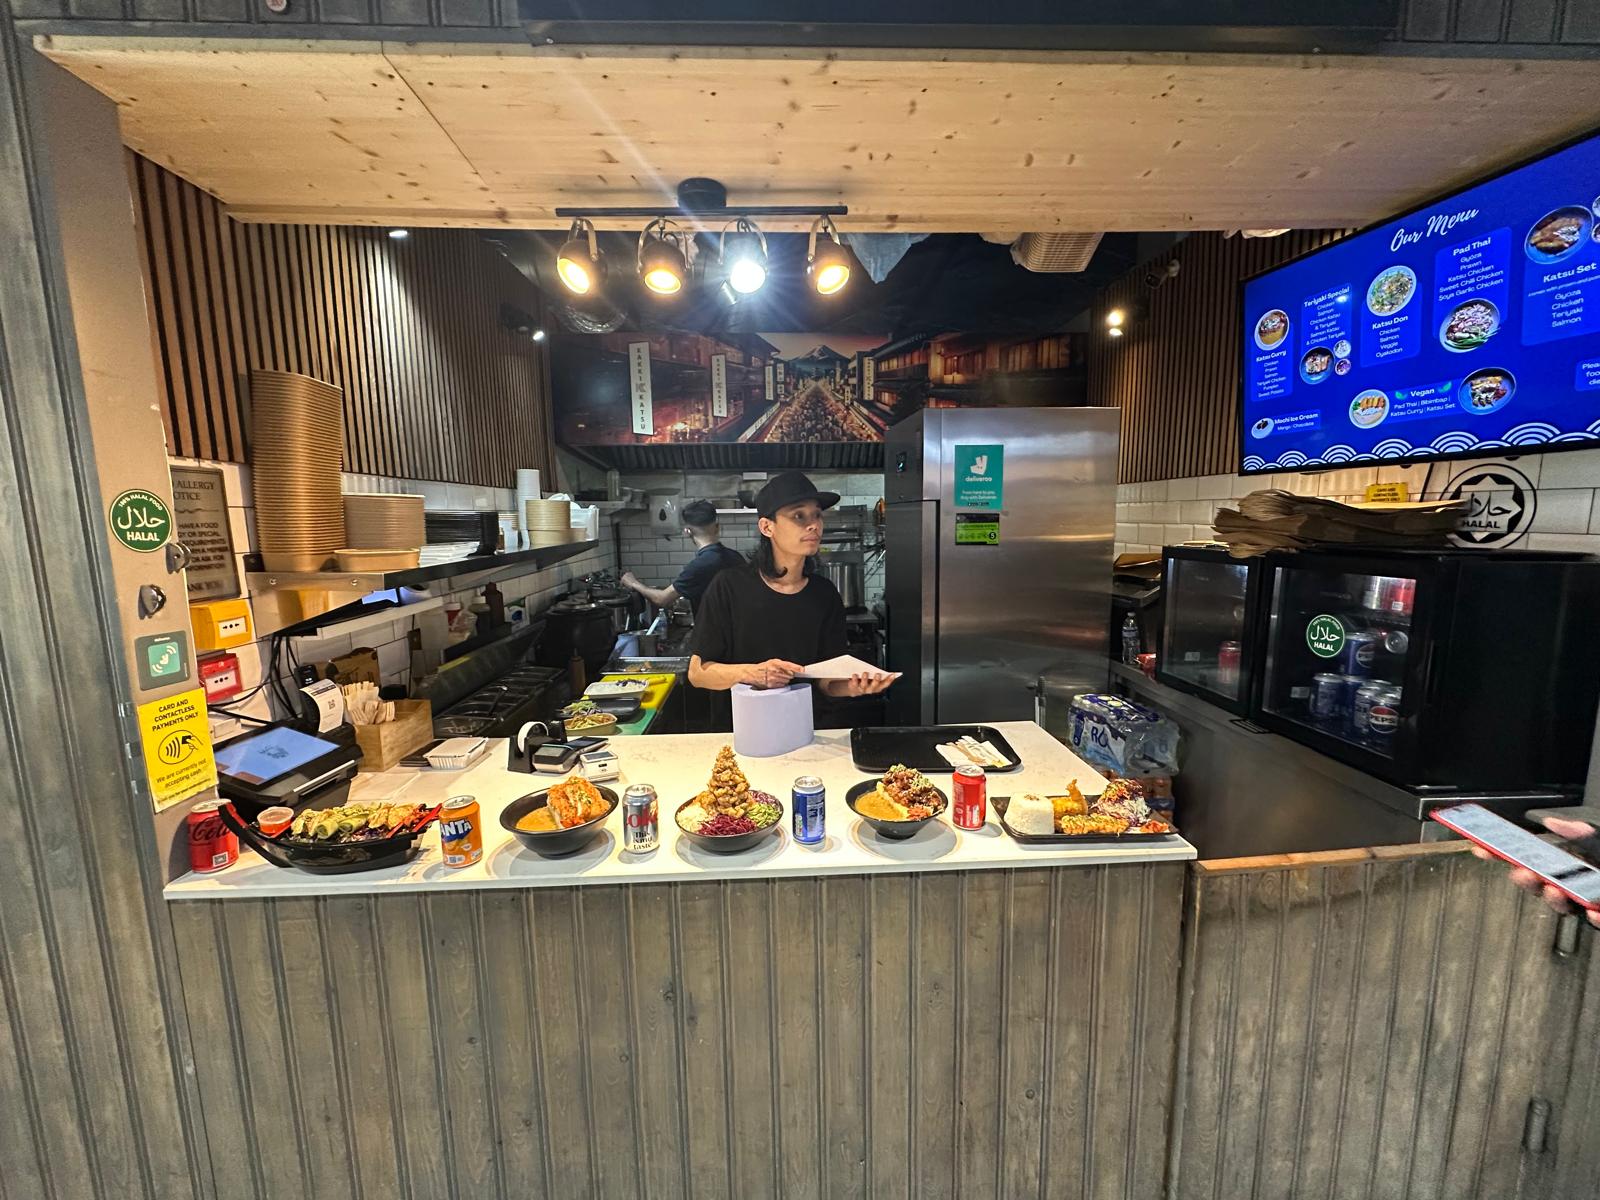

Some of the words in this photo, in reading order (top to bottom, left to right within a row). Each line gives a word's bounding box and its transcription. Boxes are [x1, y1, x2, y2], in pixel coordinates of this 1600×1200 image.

[1391, 228, 1423, 252] Our
[1426, 209, 1480, 237] Menu
[1453, 244, 1471, 256] Pad
[1471, 236, 1491, 250] Thai
[1543, 269, 1575, 283] Katsu
[1576, 262, 1597, 274] Set
[1554, 289, 1582, 300] Gyoza
[1551, 297, 1584, 310] Chicken
[1372, 320, 1394, 330] Katsu
[1393, 315, 1409, 324] Don
[1410, 388, 1436, 398] Vegan
[639, 394, 647, 430] KATSU
[176, 480, 215, 490] ALLERGY
[174, 491, 201, 501] OTICE
[117, 505, 166, 530] حلال
[126, 531, 161, 542] HALAL
[1310, 625, 1341, 641] حلال
[1313, 641, 1335, 652] HALAL
[154, 704, 196, 723] CONTACTLESS
[158, 703, 176, 713] CARD
[176, 699, 189, 707] AND
[151, 716, 184, 732] PAYMENTS
[184, 711, 199, 721] ONLY
